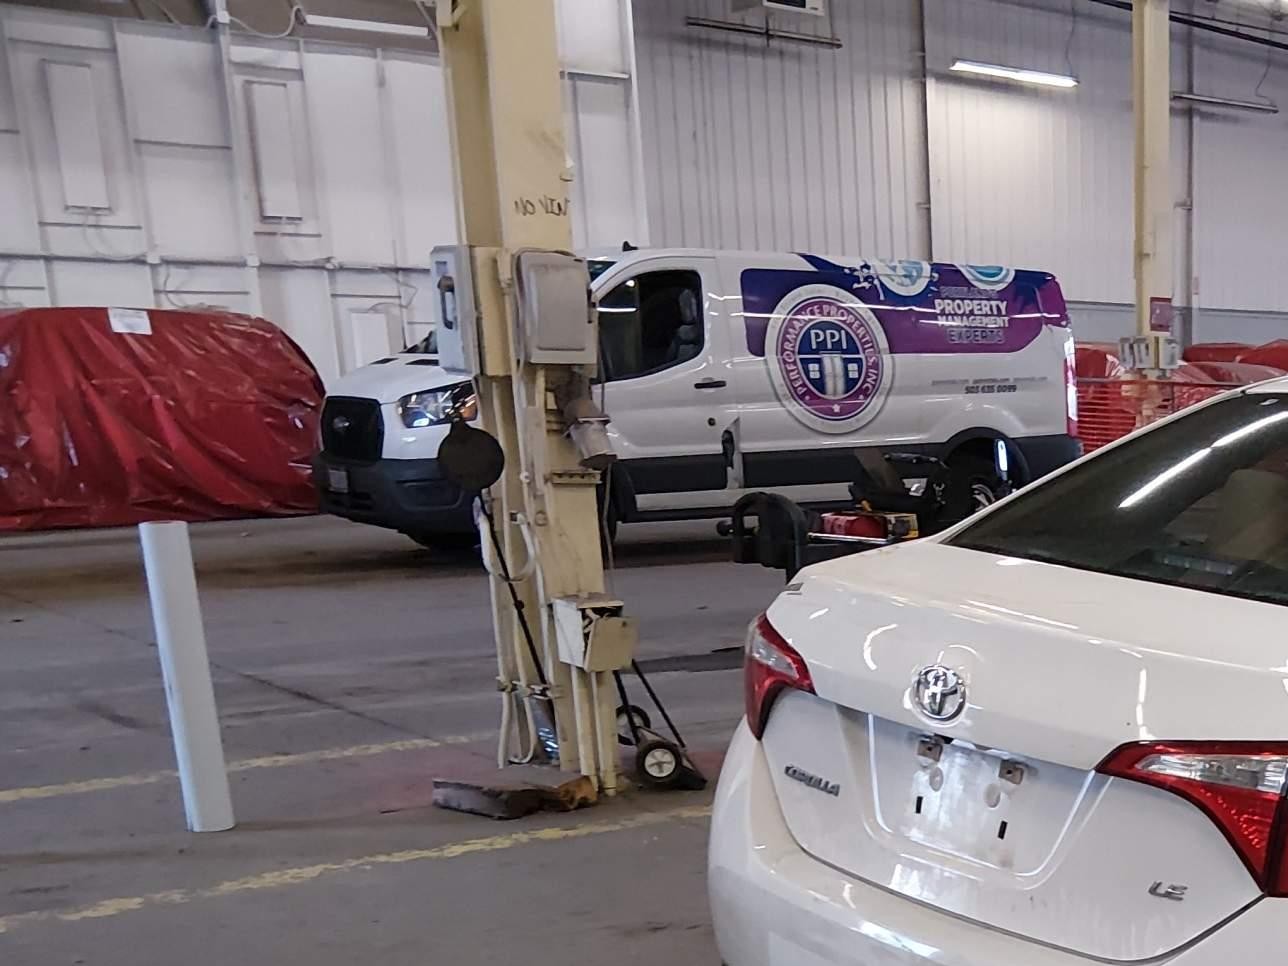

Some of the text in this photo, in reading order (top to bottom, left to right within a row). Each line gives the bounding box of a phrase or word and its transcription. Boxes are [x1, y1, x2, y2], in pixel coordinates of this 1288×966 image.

[934, 299, 1008, 315] PROPERTY
[937, 315, 1010, 328] MANAGEMENT
[782, 304, 821, 395] PERFORMANCE
[821, 304, 876, 366] PROPERTIES
[809, 329, 847, 350] PPI
[1148, 881, 1188, 901] LE
